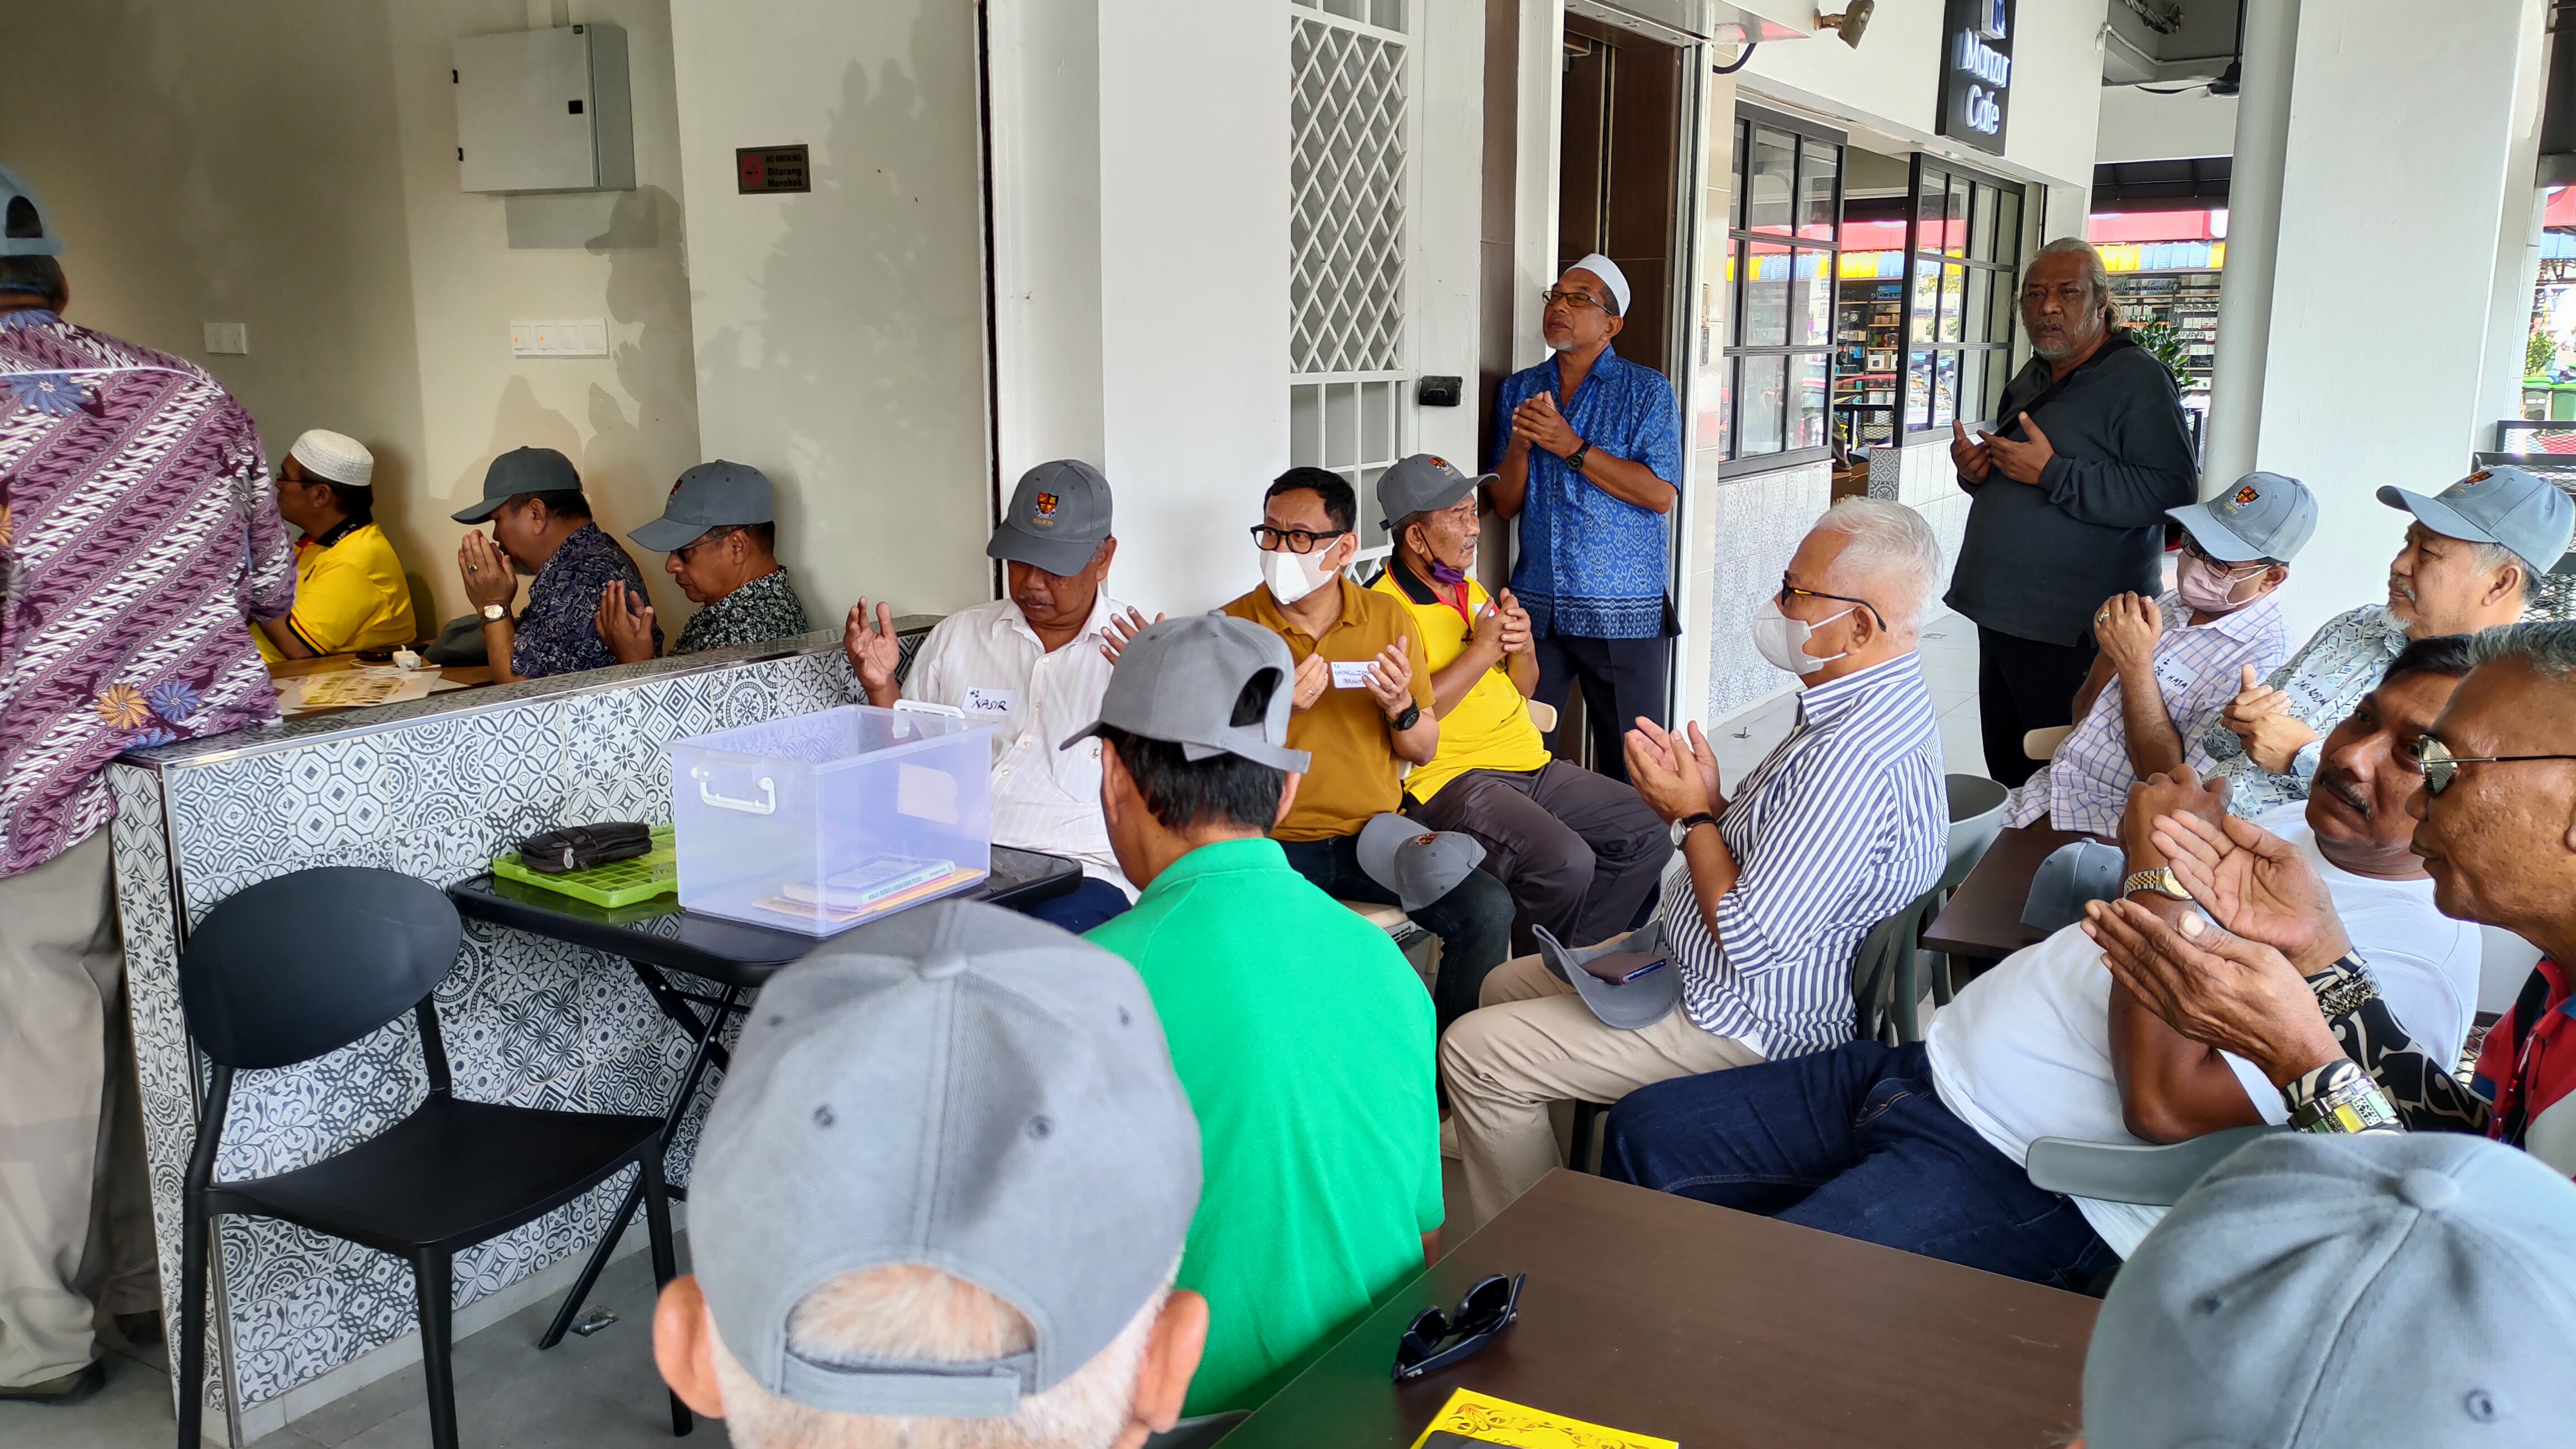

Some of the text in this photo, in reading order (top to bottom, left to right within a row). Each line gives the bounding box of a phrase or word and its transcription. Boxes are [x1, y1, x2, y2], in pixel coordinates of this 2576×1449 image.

[1962, 28, 2010, 88] Manzur
[1966, 84, 2000, 135] Cafe
[775, 154, 802, 163] SMOKING
[768, 168, 802, 177] Dilarang
[768, 178, 803, 187] Merokok
[2166, 675, 2188, 689] HAJA
[971, 698, 1008, 711] NASIR
